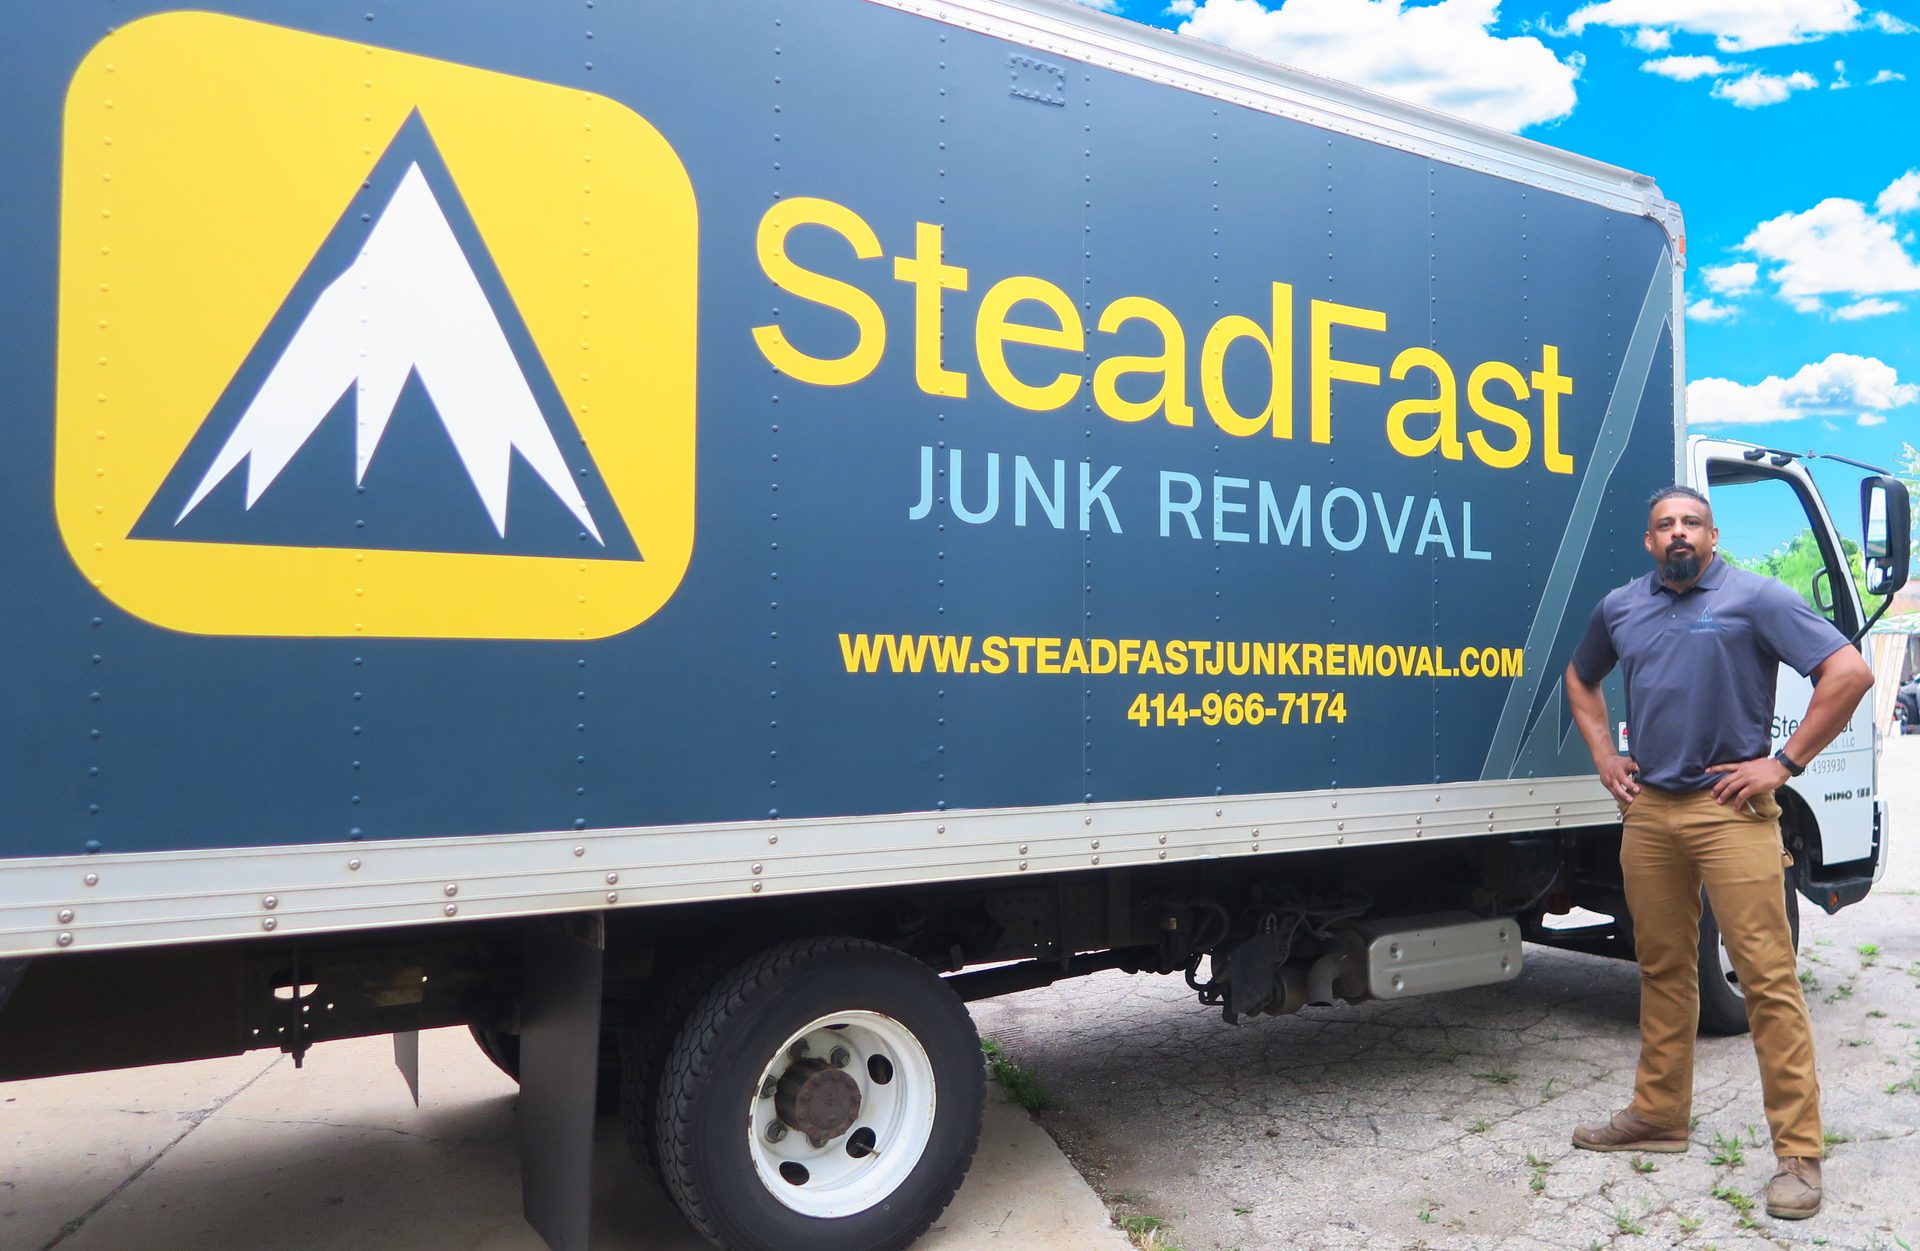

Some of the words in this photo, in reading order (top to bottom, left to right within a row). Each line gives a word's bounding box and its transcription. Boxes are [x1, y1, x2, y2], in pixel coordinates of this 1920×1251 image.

[751, 196, 1574, 475] SteadFast
[908, 445, 1123, 536] JUNK
[1159, 469, 1492, 562] REMOVAL
[838, 633, 1524, 678] WWW.STEADFASTJUNKREMOVAL.COM
[1127, 691, 1347, 727] 414-966-7174
[1842, 736, 1855, 748] LLC
[1811, 757, 1846, 775] 4393930
[1824, 789, 1853, 802] HINO
